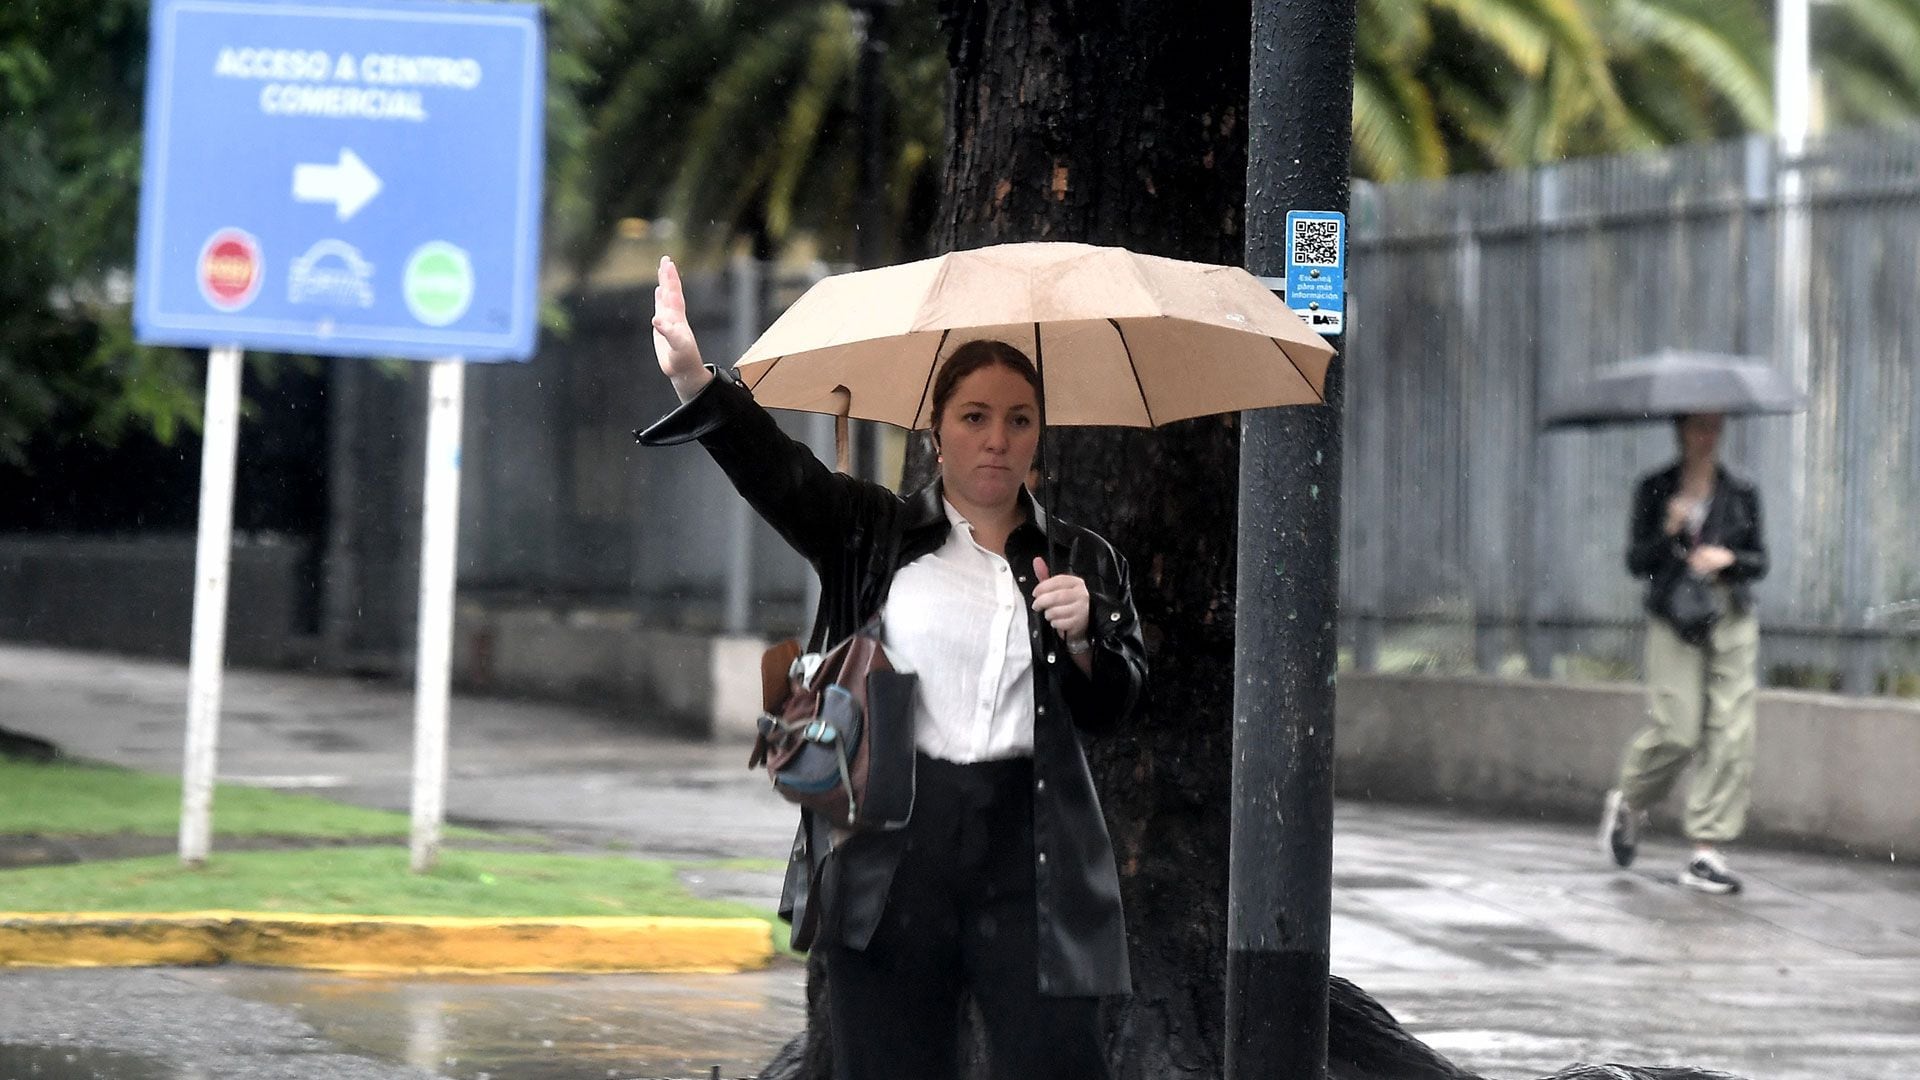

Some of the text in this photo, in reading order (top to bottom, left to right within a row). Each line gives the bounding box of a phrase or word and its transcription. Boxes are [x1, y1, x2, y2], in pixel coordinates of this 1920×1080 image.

[216, 47, 481, 89] ACCESO A CENTRO
[260, 83, 427, 121] COMERCIAL
[1313, 315, 1330, 325] BA
